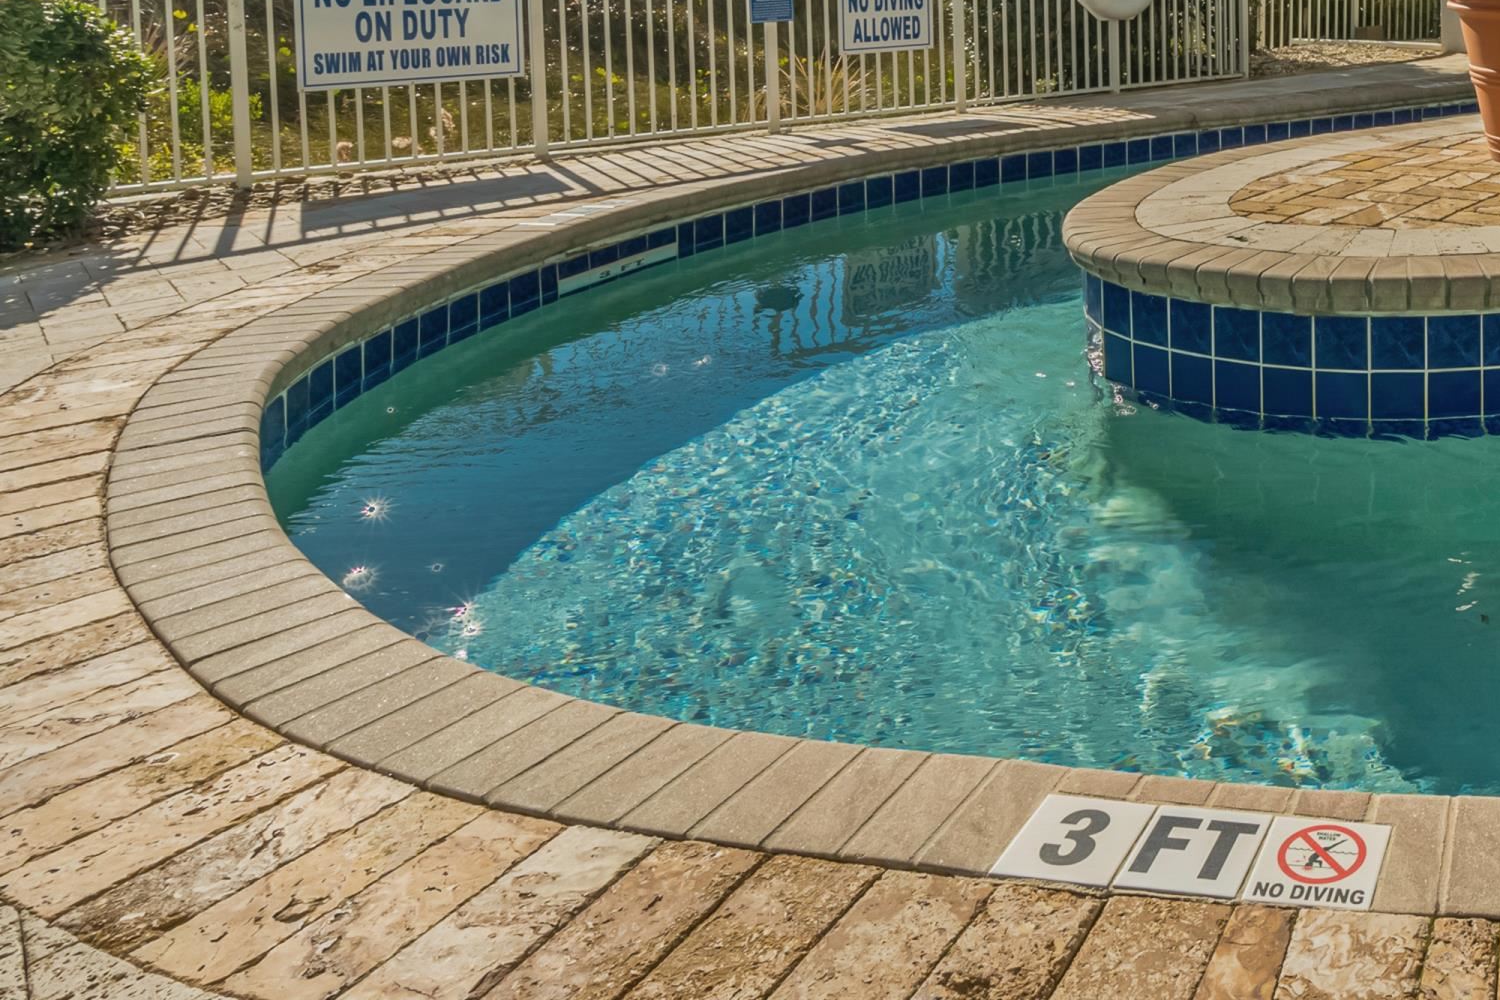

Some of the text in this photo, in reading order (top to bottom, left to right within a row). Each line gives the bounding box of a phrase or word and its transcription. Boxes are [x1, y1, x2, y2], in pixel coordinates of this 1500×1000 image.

[355, 8, 470, 43] ON DUTY
[853, 16, 921, 43] ALLOWED
[314, 43, 510, 75] SWIM AT YOUR OWN RISK
[1038, 808, 1261, 880] 3 FT
[1252, 881, 1366, 905] NO DIVING
